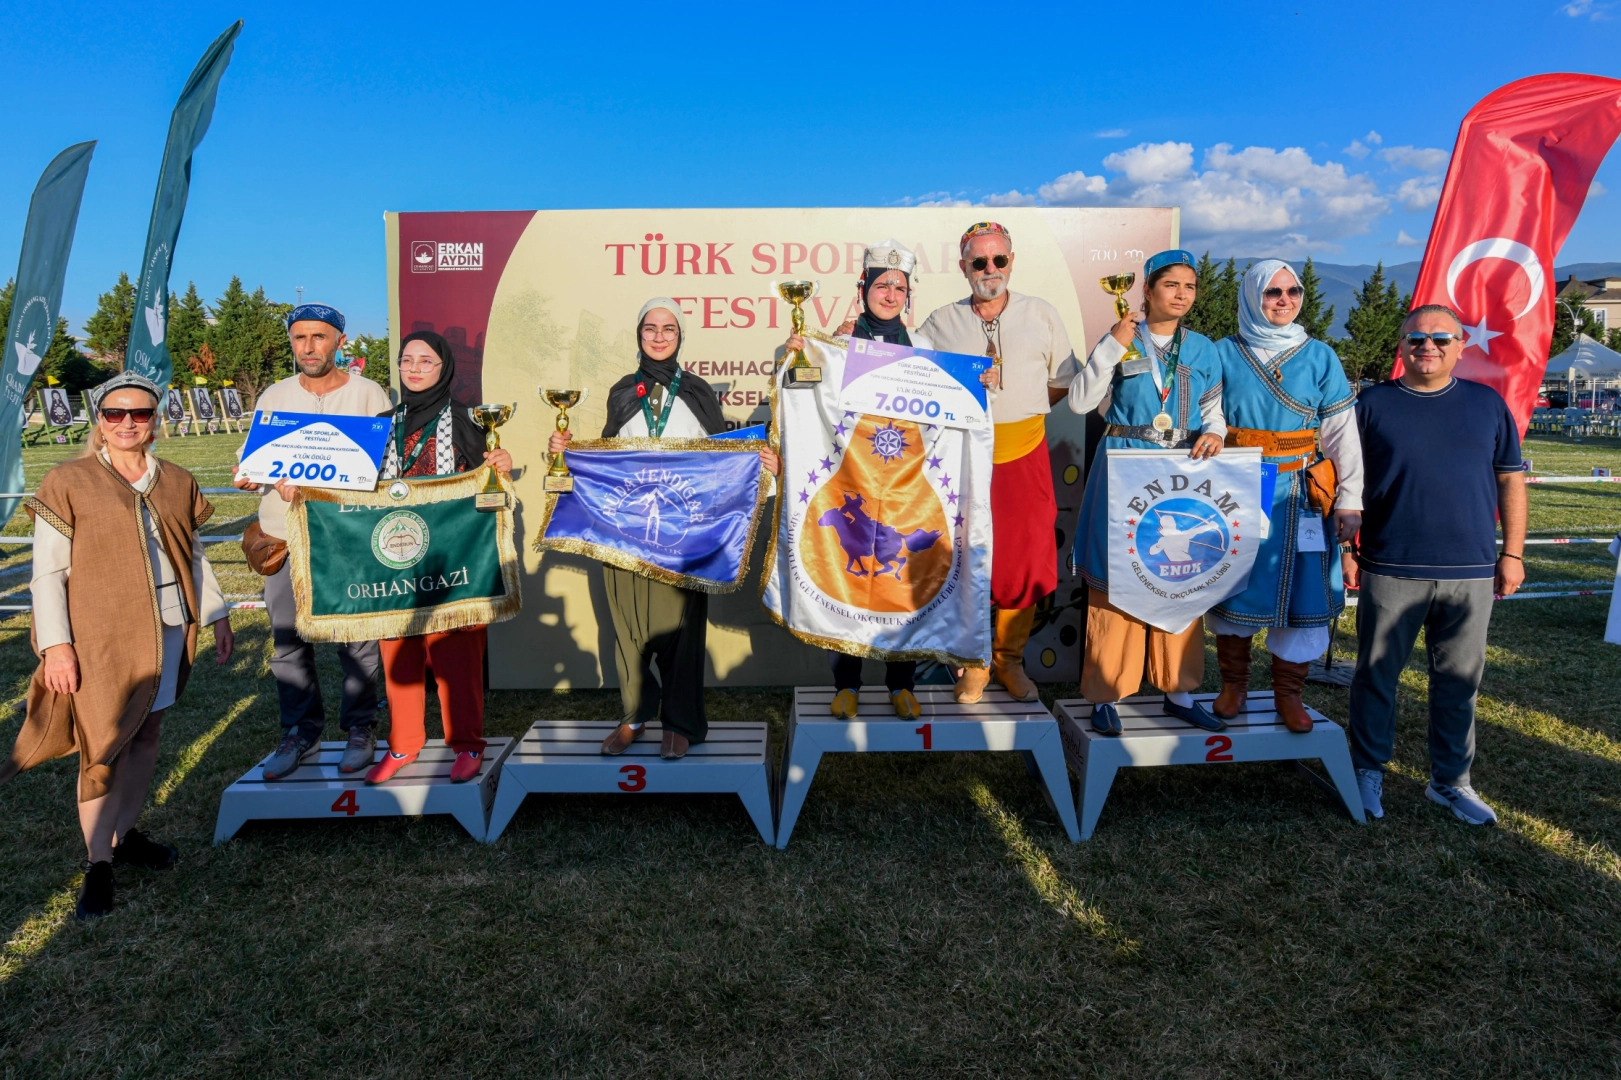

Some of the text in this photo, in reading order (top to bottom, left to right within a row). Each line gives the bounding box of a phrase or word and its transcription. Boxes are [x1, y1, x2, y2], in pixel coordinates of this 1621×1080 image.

[438, 243, 483, 254] ERKAN
[440, 255, 481, 266] AYDIN
[605, 233, 735, 276] TÜRK
[904, 370, 931, 378] FESTİVALİ
[912, 364, 940, 373] SPORLARI
[714, 391, 769, 406] KSEL
[912, 388, 932, 396] ÖDÜLÜ
[875, 392, 956, 421] 7.000 TL
[268, 460, 337, 481] 2.000
[339, 474, 350, 483] TL
[1522, 461, 1528, 471] 6
[1127, 474, 1240, 517] ENDAM
[347, 566, 469, 599] ORHANGAZİ
[1132, 561, 1231, 599] GELENEKSEL OKÇULUK KULÜBÜ
[1160, 563, 1201, 576] ENOK
[800, 580, 852, 619] GELENEKSEL
[853, 613, 903, 626] OKÇULUK
[916, 724, 932, 750] 1
[1205, 735, 1233, 762] 2
[618, 765, 646, 792] 3
[331, 790, 360, 816] 4
